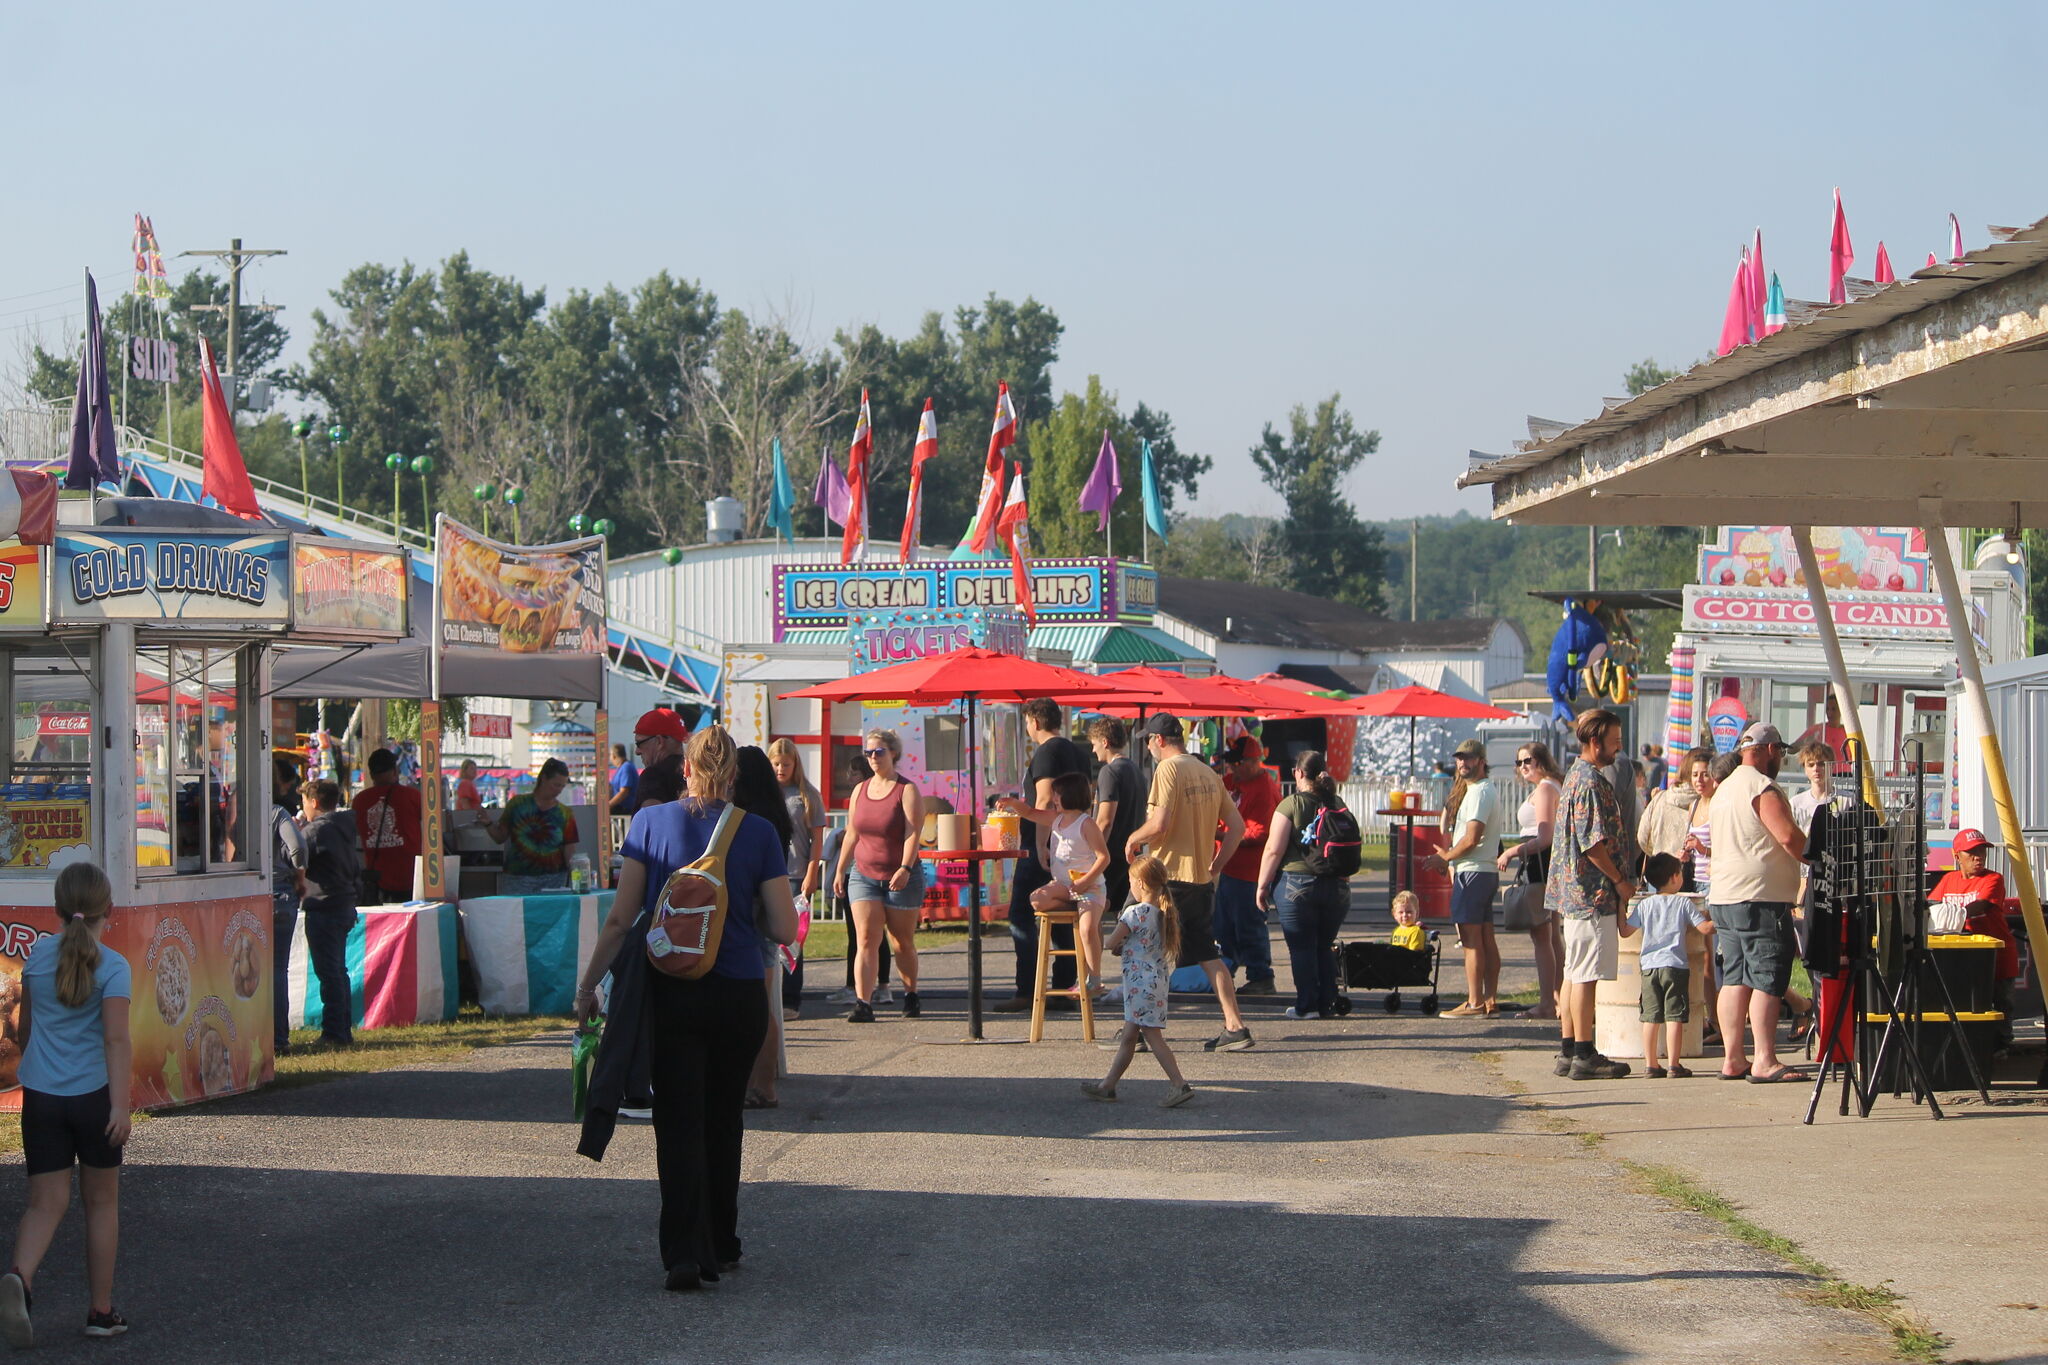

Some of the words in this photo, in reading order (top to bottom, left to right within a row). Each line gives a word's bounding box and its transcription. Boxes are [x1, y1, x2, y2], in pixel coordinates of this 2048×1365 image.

[132, 336, 179, 384] SLIDE
[72, 543, 149, 604] COLD
[156, 542, 270, 606] DRINKS
[794, 580, 837, 609] ICE
[841, 578, 926, 608] CREAM
[955, 575, 1092, 606] DELIHTS
[1847, 604, 1950, 626] CANDY
[460, 625, 483, 644] Cheese
[483, 628, 499, 644] Fries
[864, 625, 970, 662] TICKETS
[48, 716, 89, 730] Coca-Cola
[11, 808, 83, 825] FUNNEL
[425, 739, 440, 889] DOGS
[24, 824, 83, 841] CAKES
[945, 866, 969, 876] RID
